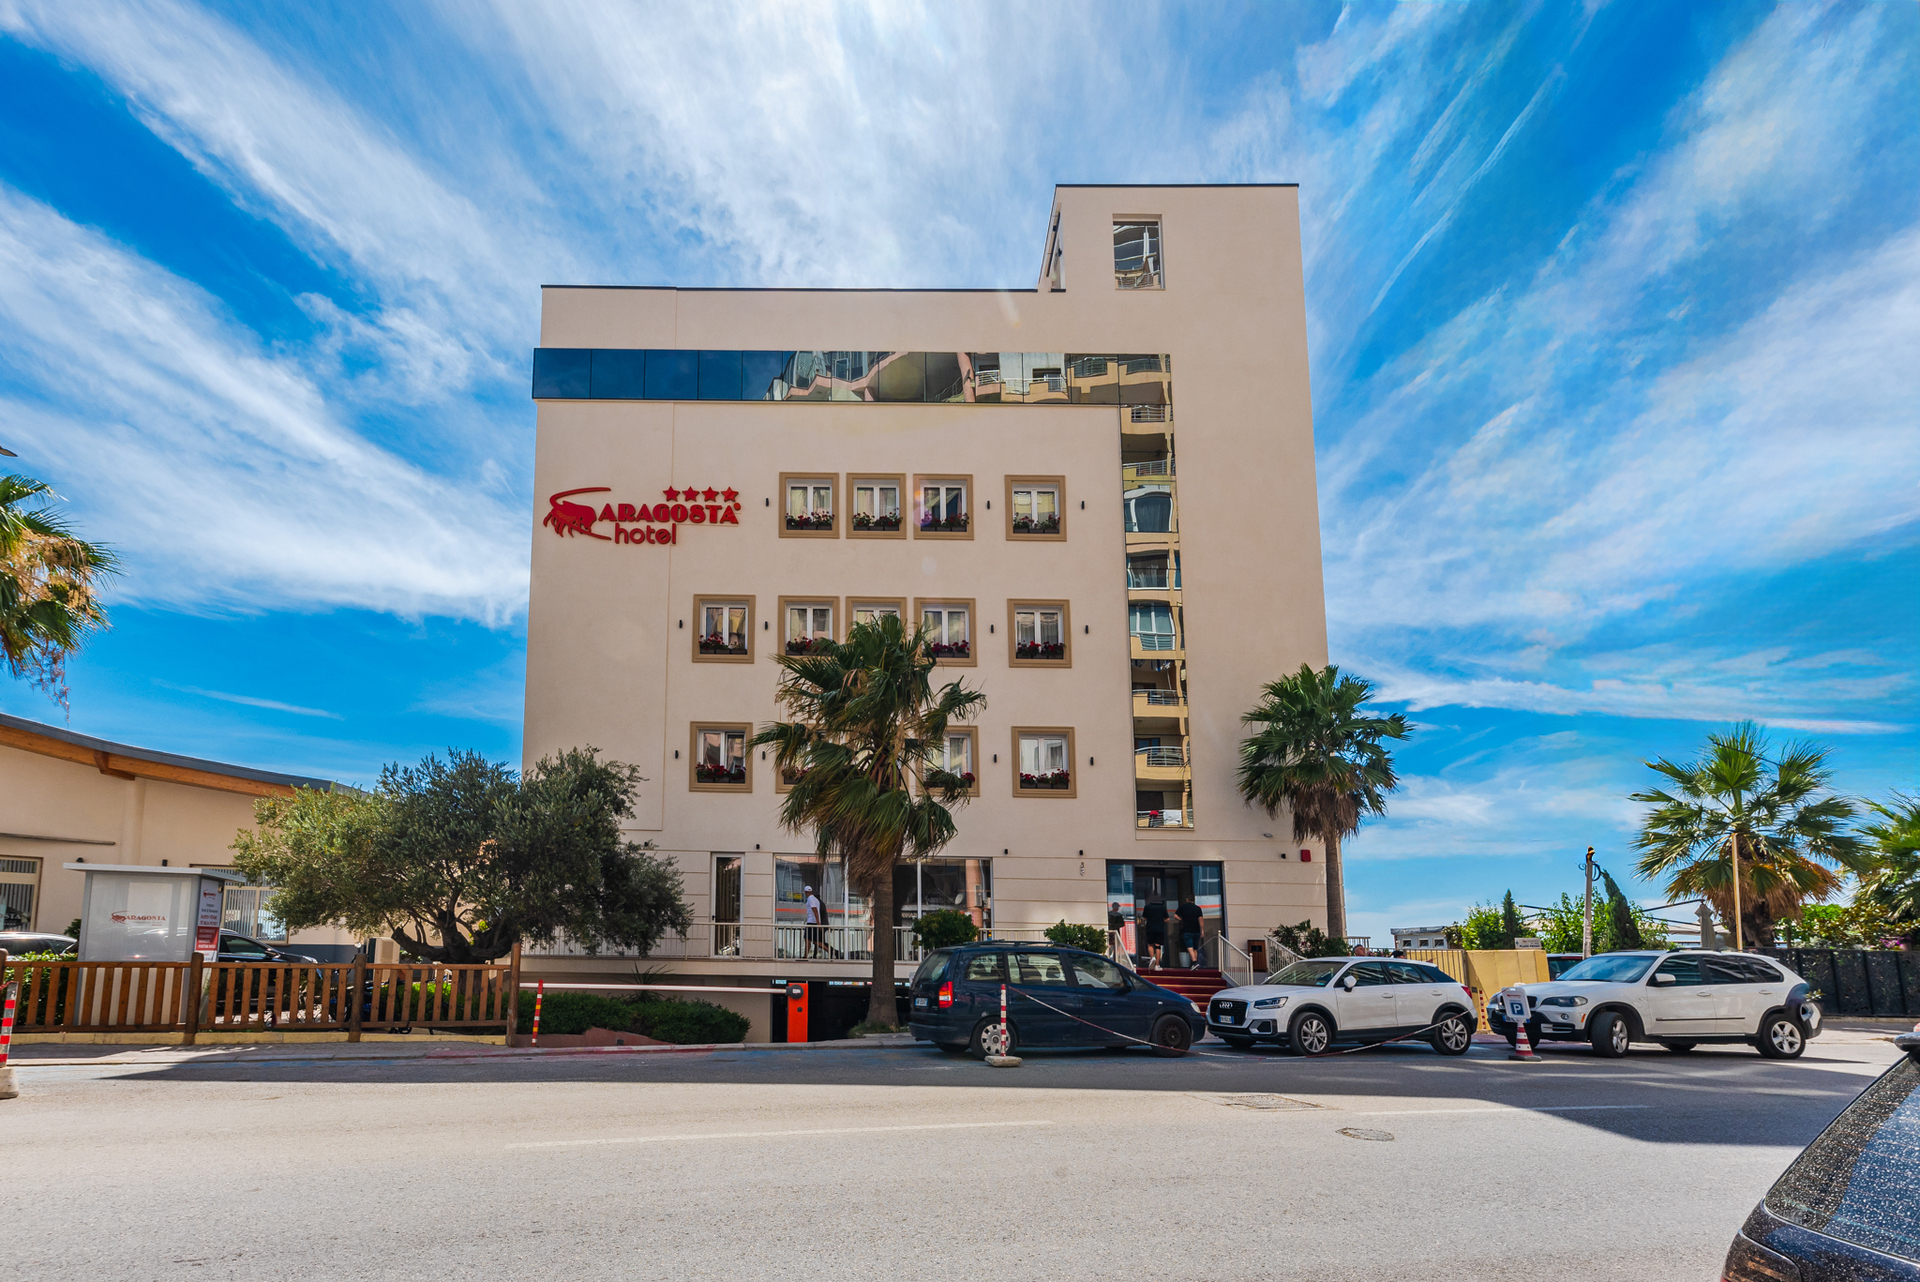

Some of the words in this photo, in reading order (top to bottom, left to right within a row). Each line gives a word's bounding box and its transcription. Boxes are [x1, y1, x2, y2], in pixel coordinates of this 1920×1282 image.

[598, 503, 739, 525] ARAGOSTA
[614, 522, 677, 545] hotel
[126, 914, 166, 922] ARAGOSTA
[1513, 1003, 1521, 1014] P
